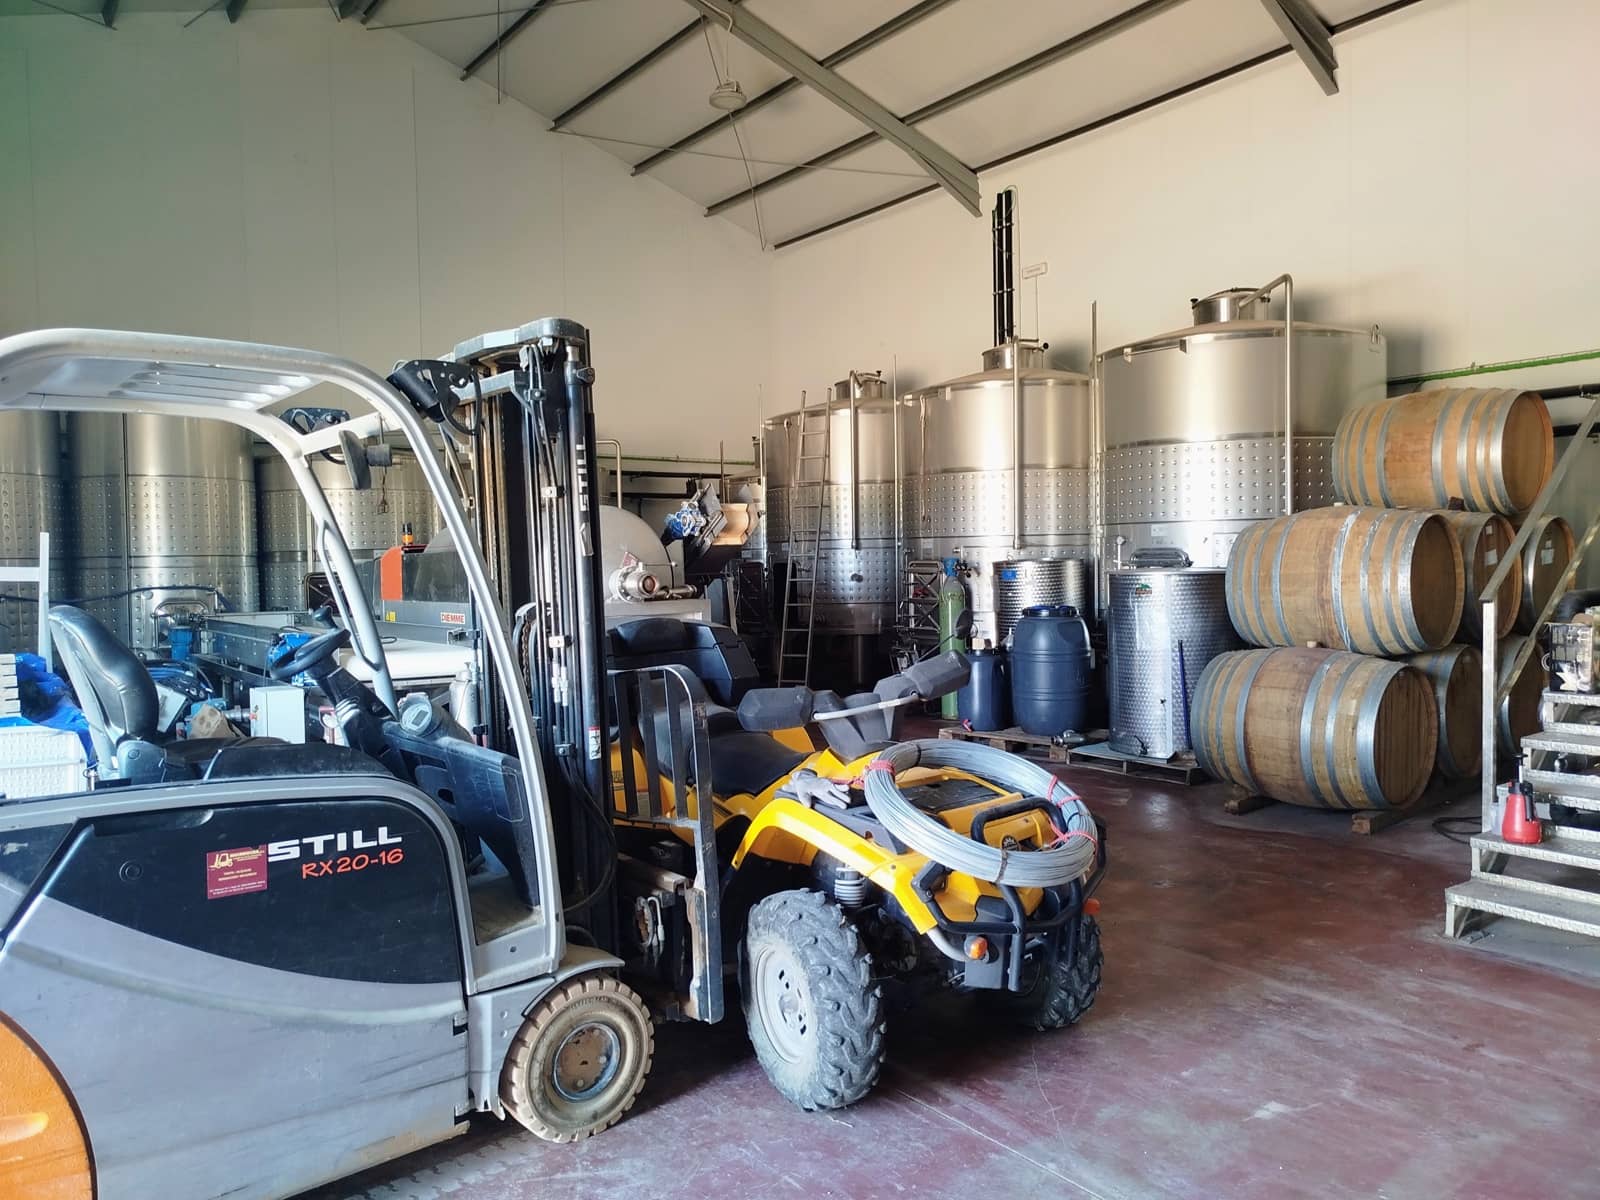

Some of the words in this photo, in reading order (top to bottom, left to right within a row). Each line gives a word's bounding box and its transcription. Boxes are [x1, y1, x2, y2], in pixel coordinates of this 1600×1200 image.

[575, 436, 590, 512] STILL
[441, 613, 465, 624] DIEMME
[267, 826, 402, 863] STILL
